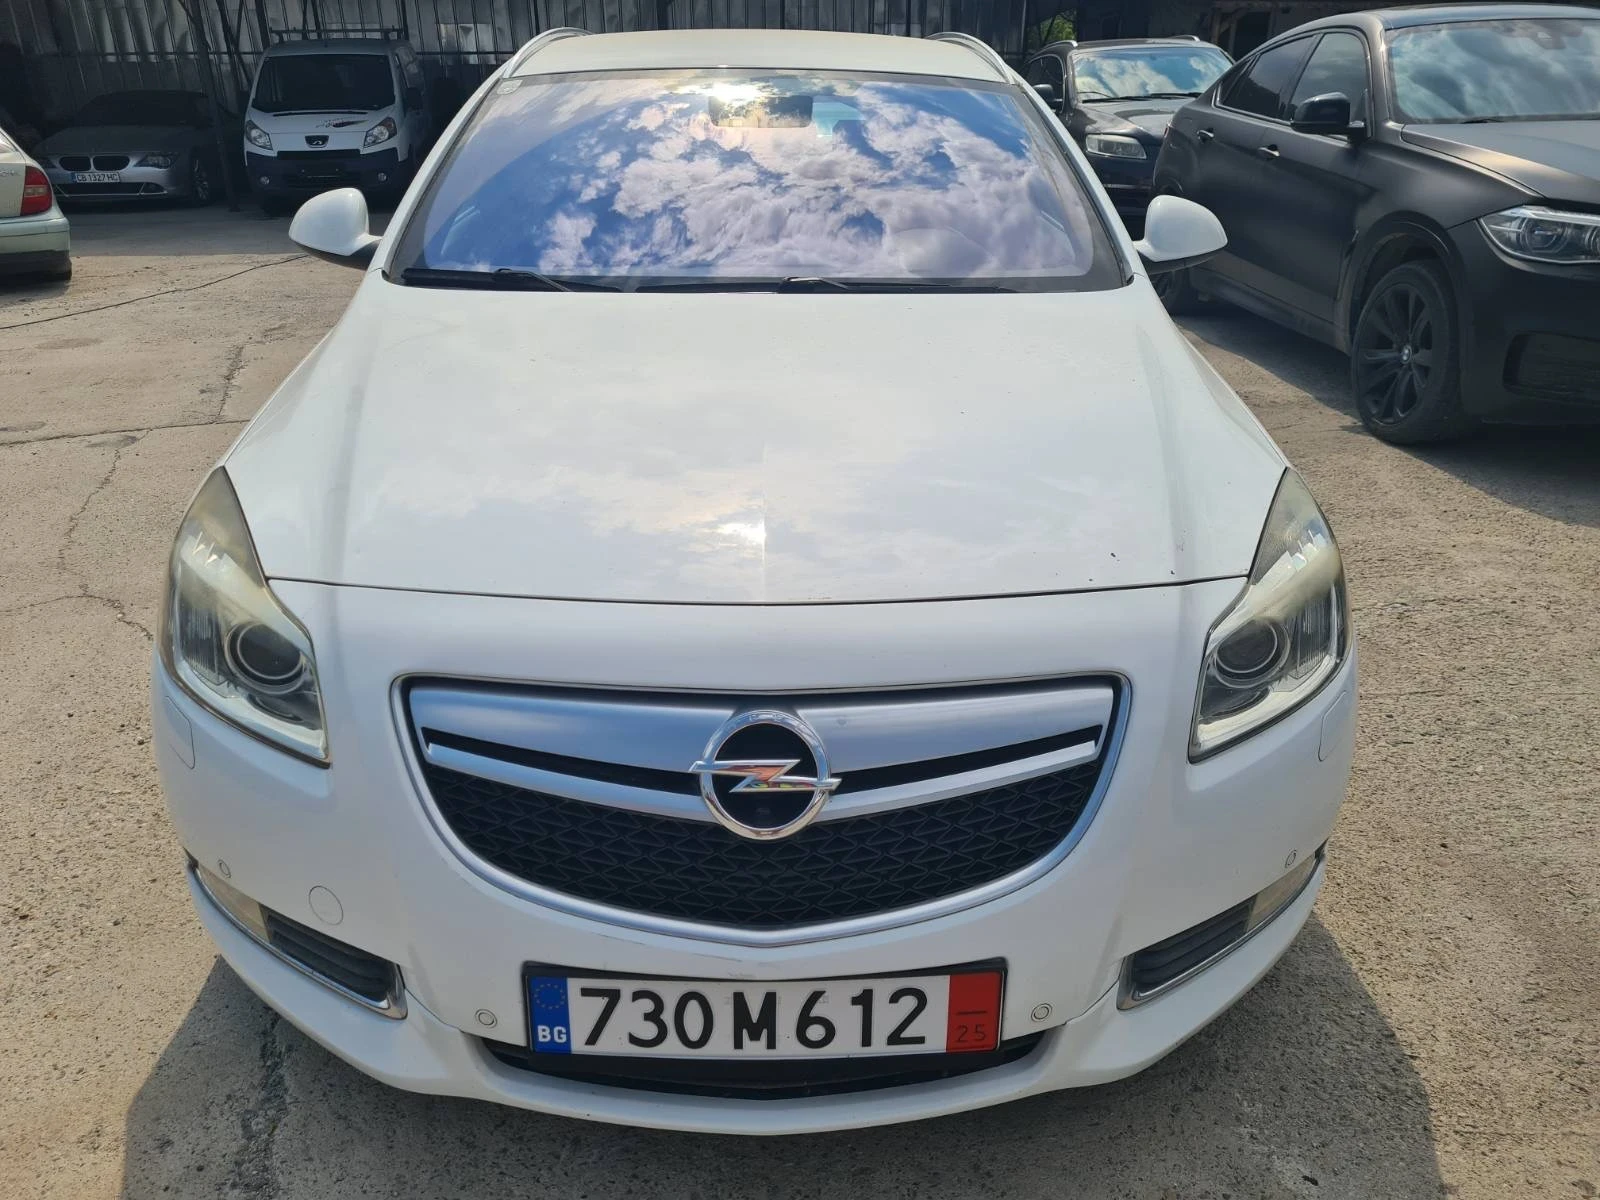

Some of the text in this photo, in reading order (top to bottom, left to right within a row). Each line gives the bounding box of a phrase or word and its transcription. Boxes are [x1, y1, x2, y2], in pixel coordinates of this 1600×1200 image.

[77, 174, 87, 182] CB
[88, 173, 105, 182] 1327
[580, 987, 928, 1050] 730 M 612
[537, 1025, 567, 1043] BG
[955, 1024, 987, 1044] 25
